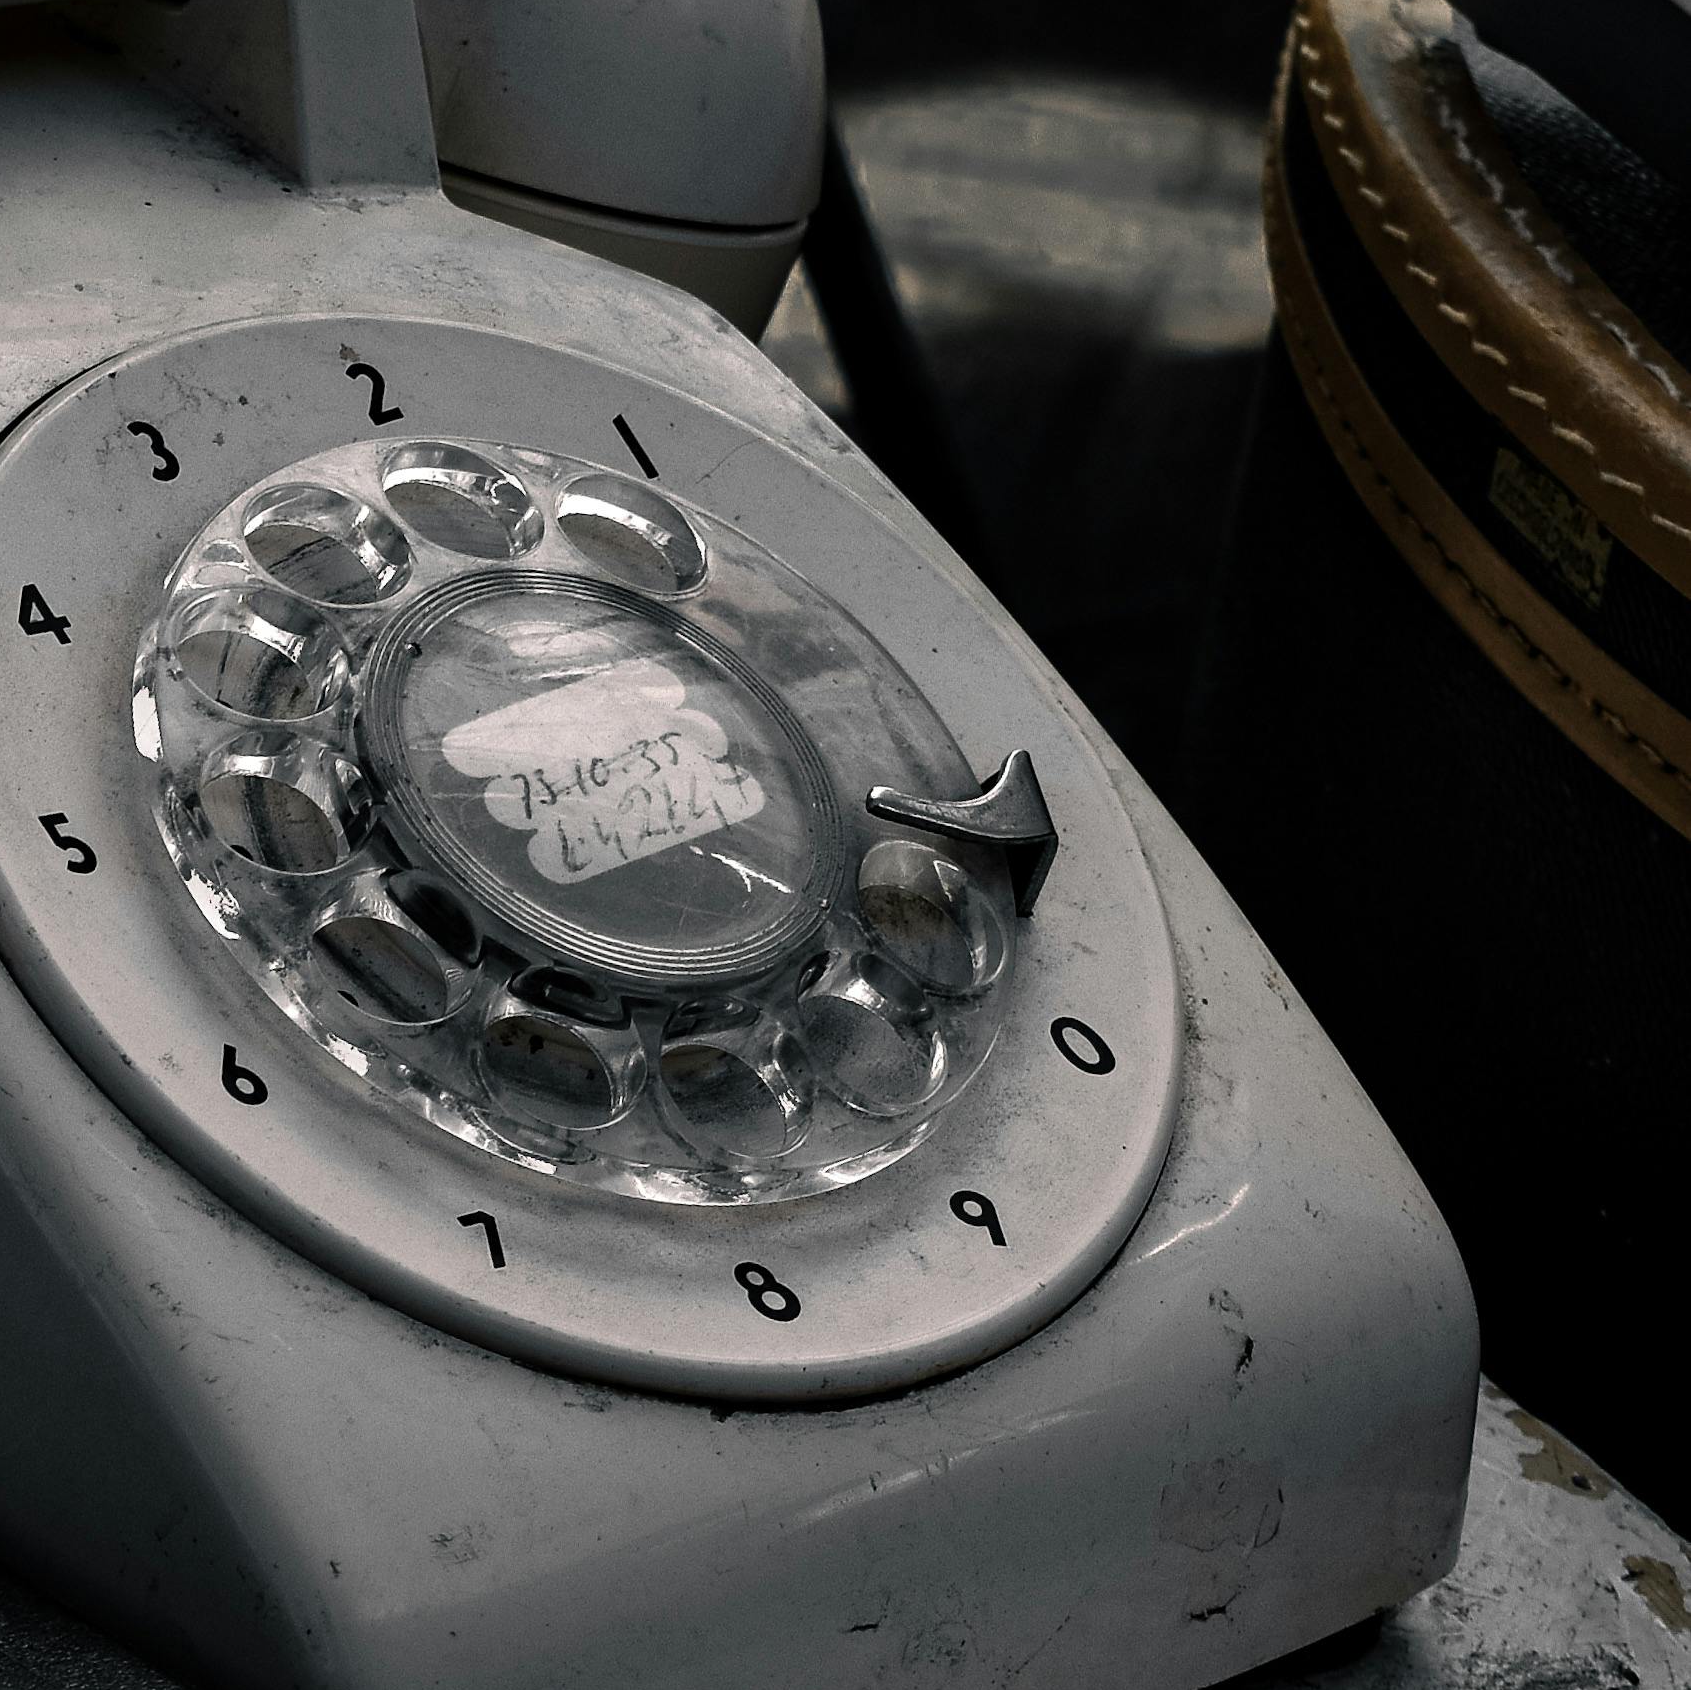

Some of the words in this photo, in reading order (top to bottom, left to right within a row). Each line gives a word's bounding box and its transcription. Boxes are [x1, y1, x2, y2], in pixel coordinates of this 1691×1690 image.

[346, 363, 404, 425] 2
[126, 420, 180, 482] 3
[612, 413, 660, 480] 1
[17, 583, 72, 645] 4
[37, 812, 98, 875] 5
[221, 1043, 269, 1106] 6
[1049, 1016, 1116, 1076] 0
[456, 1210, 507, 1269] 7
[949, 1190, 1007, 1247] 9
[733, 1261, 802, 1323] 8
